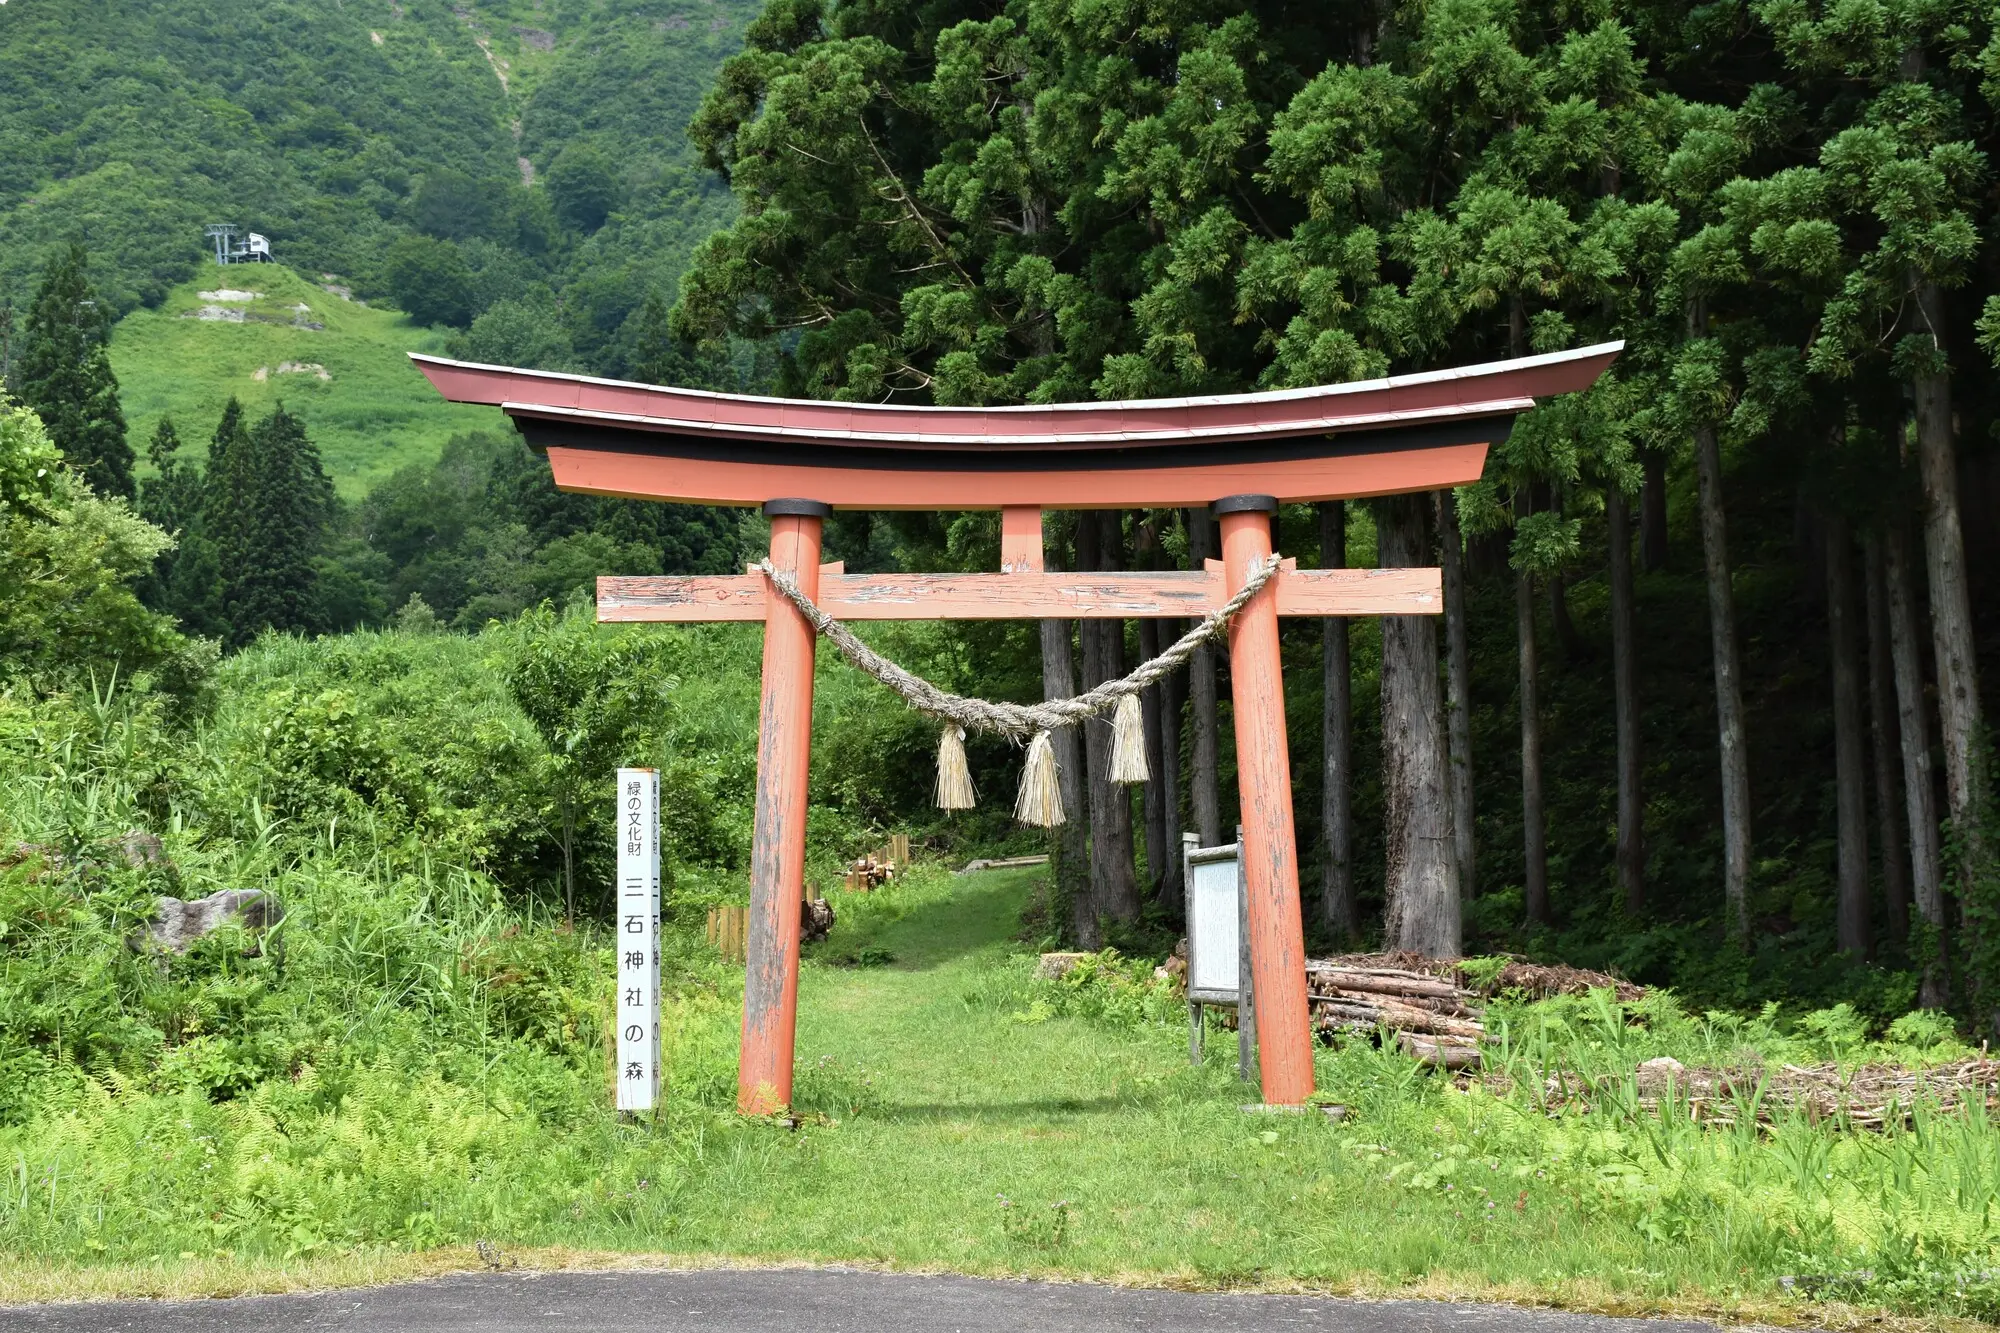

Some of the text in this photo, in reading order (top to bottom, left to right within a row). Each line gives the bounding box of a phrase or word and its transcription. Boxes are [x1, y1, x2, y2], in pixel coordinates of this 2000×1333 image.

[624, 781, 644, 1081] 緑の文化財 三石神社の森
